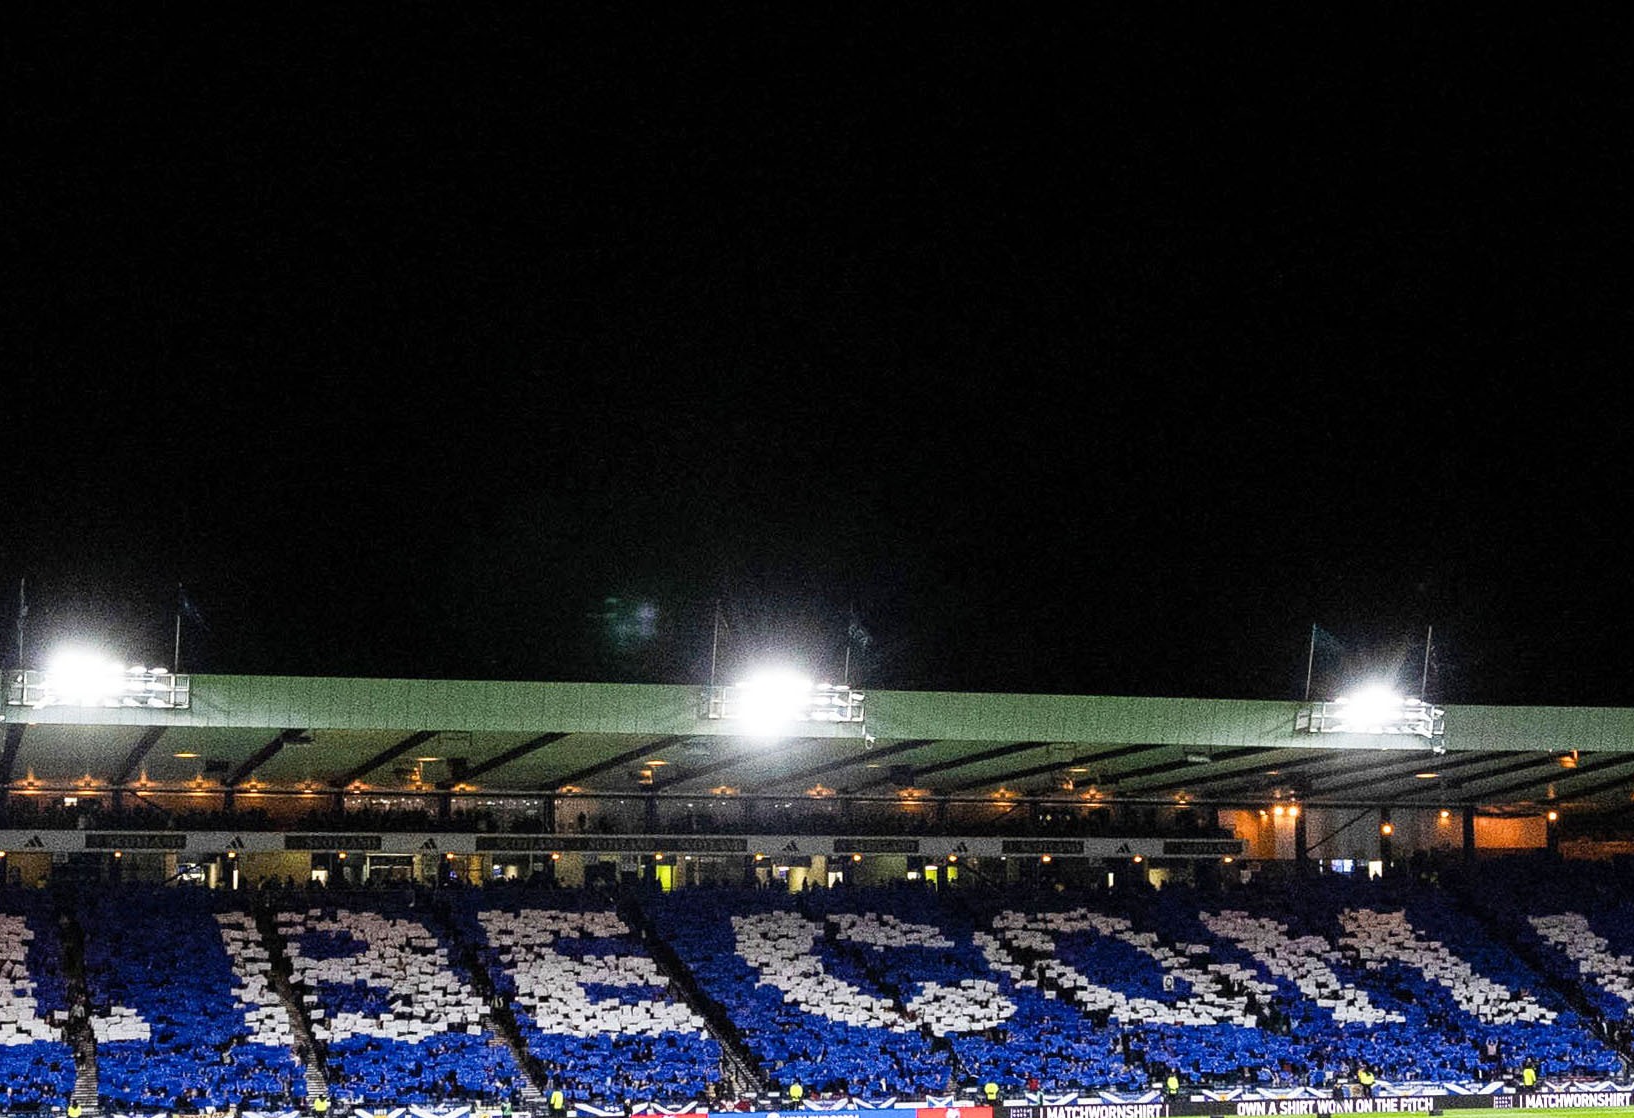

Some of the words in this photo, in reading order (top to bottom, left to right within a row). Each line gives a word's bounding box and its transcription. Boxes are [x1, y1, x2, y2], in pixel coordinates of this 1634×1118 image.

[1237, 1101, 1265, 1117] OWN
[1268, 1101, 1277, 1116] A
[1279, 1100, 1316, 1116] SHIRT
[1356, 1099, 1373, 1114] ON
[1375, 1098, 1397, 1113] THE
[1525, 1092, 1632, 1109] MATCHWORNSHIRT
